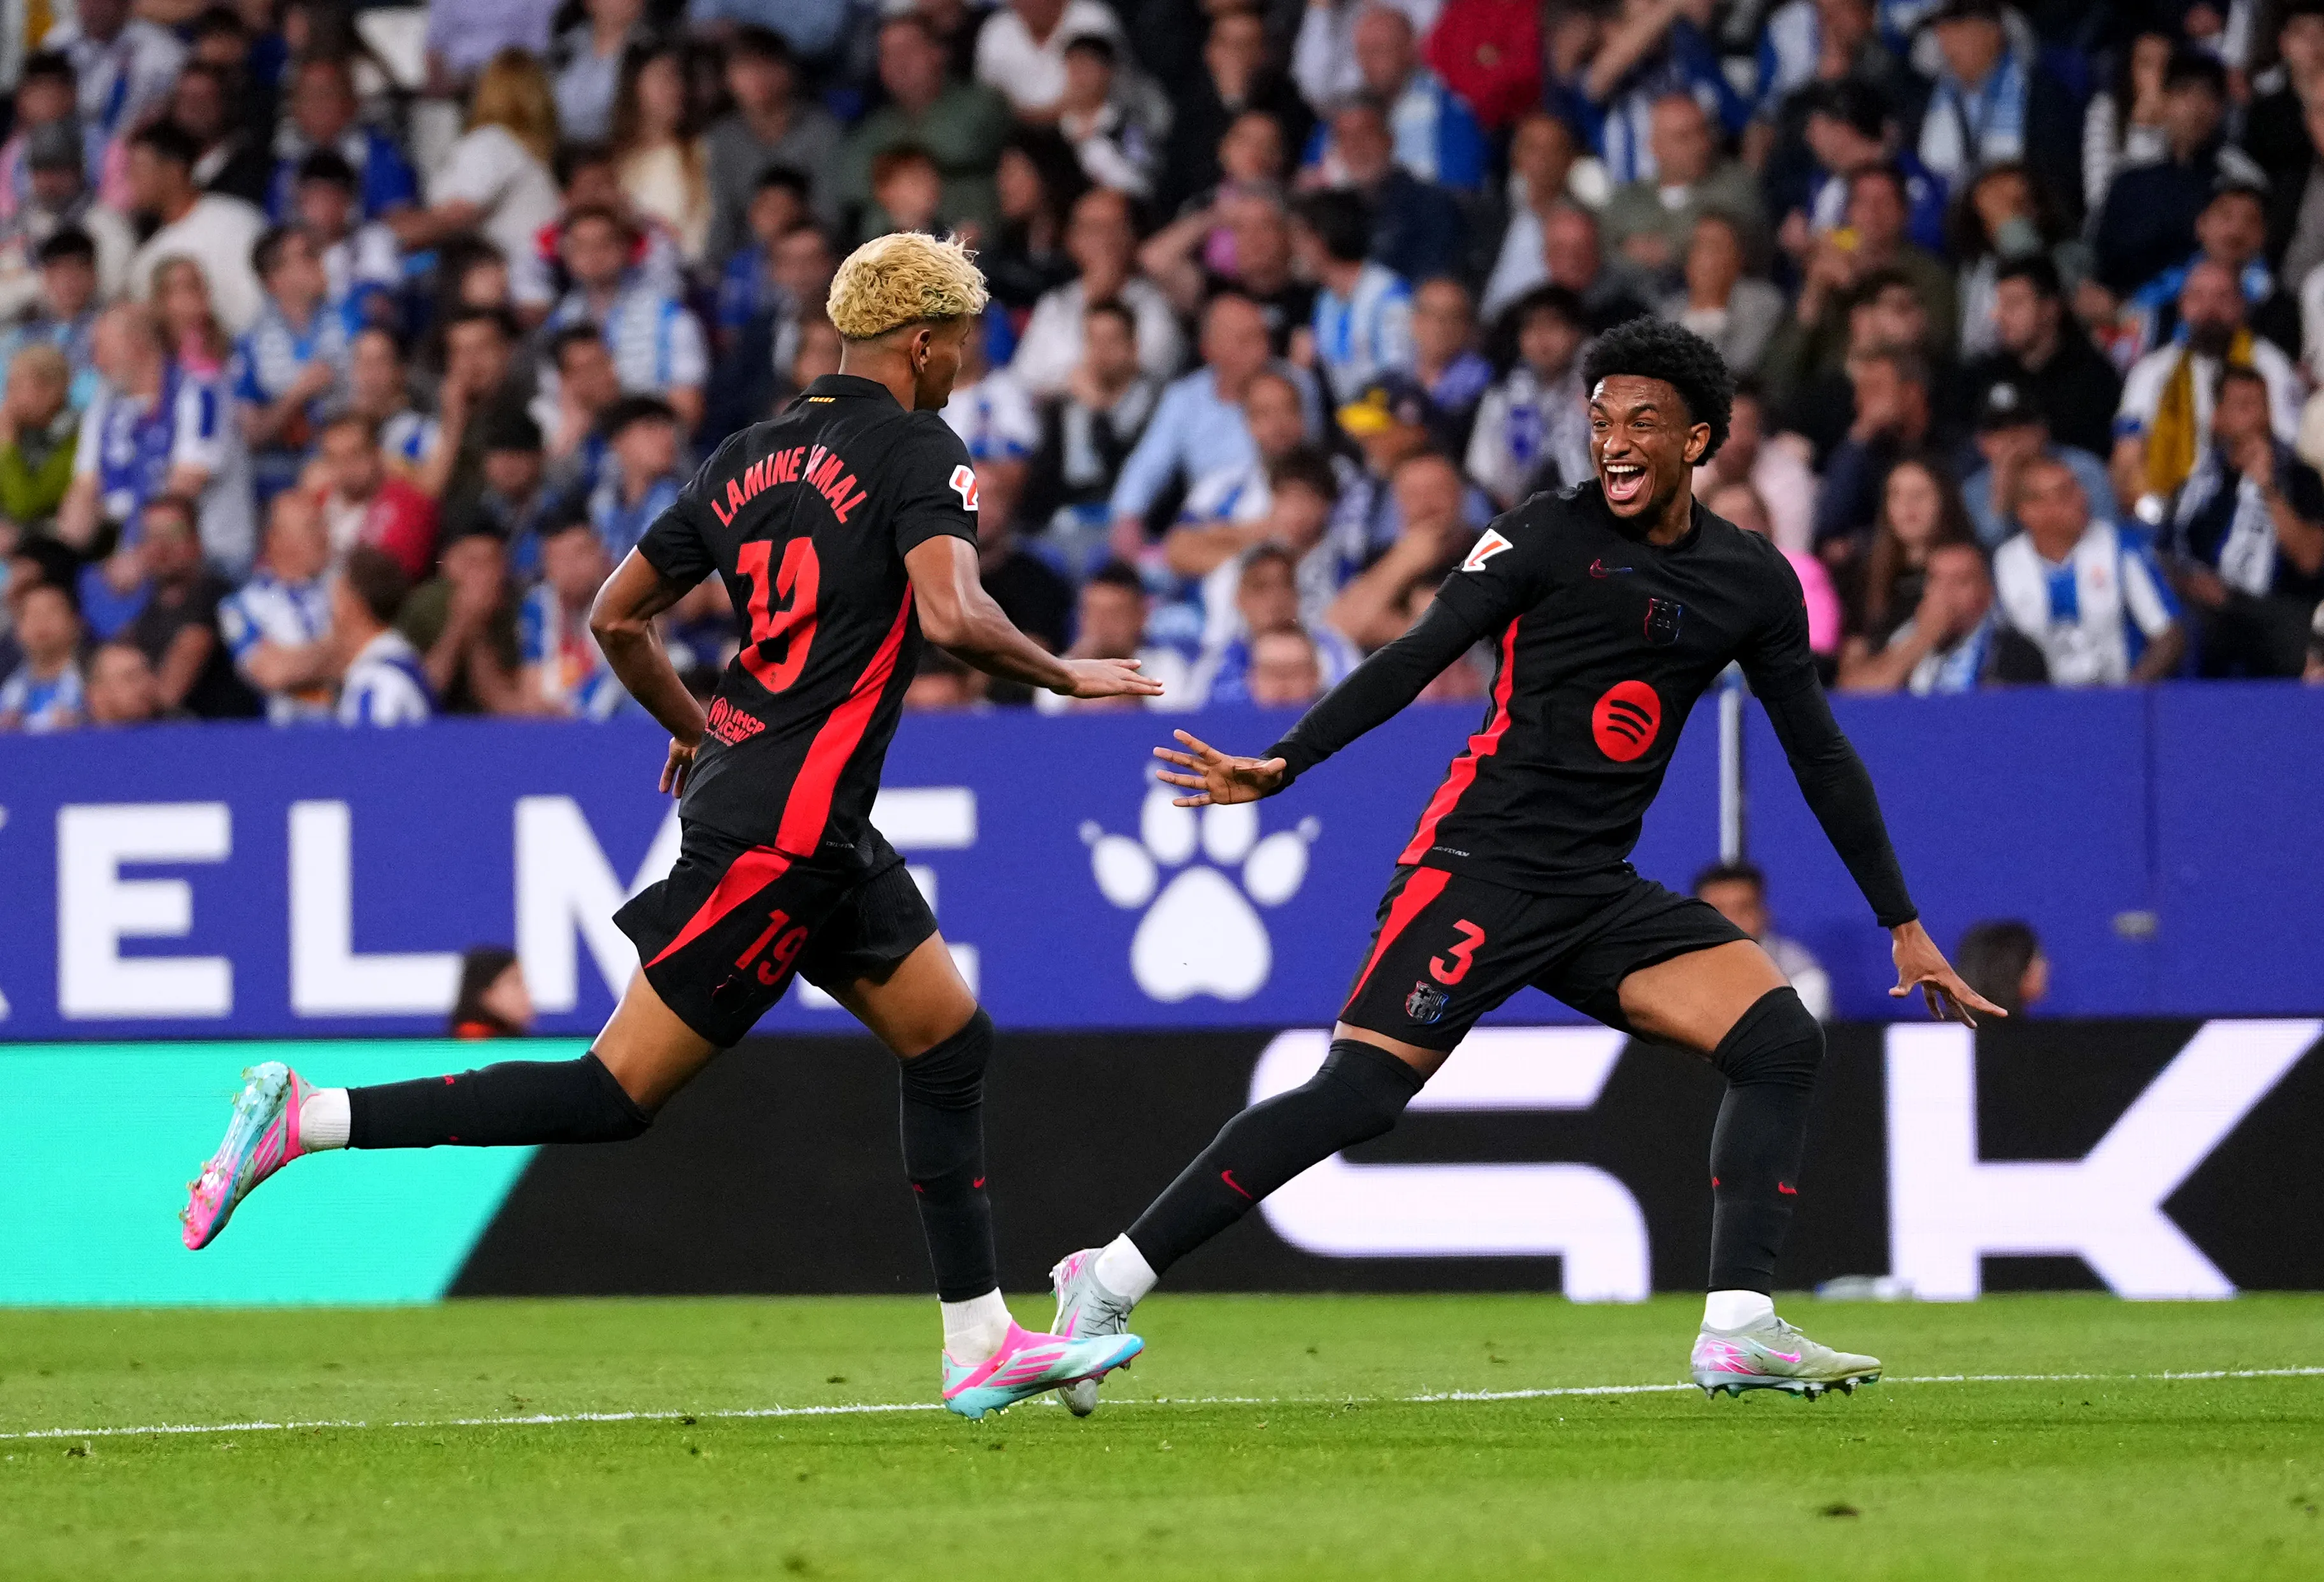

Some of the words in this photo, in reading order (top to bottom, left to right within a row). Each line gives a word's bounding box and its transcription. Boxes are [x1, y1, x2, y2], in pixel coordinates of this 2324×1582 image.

[711, 446, 806, 528] LAMINE
[0, 787, 981, 1022] ELM
[735, 909, 808, 985] 19
[1429, 918, 1485, 985] 3
